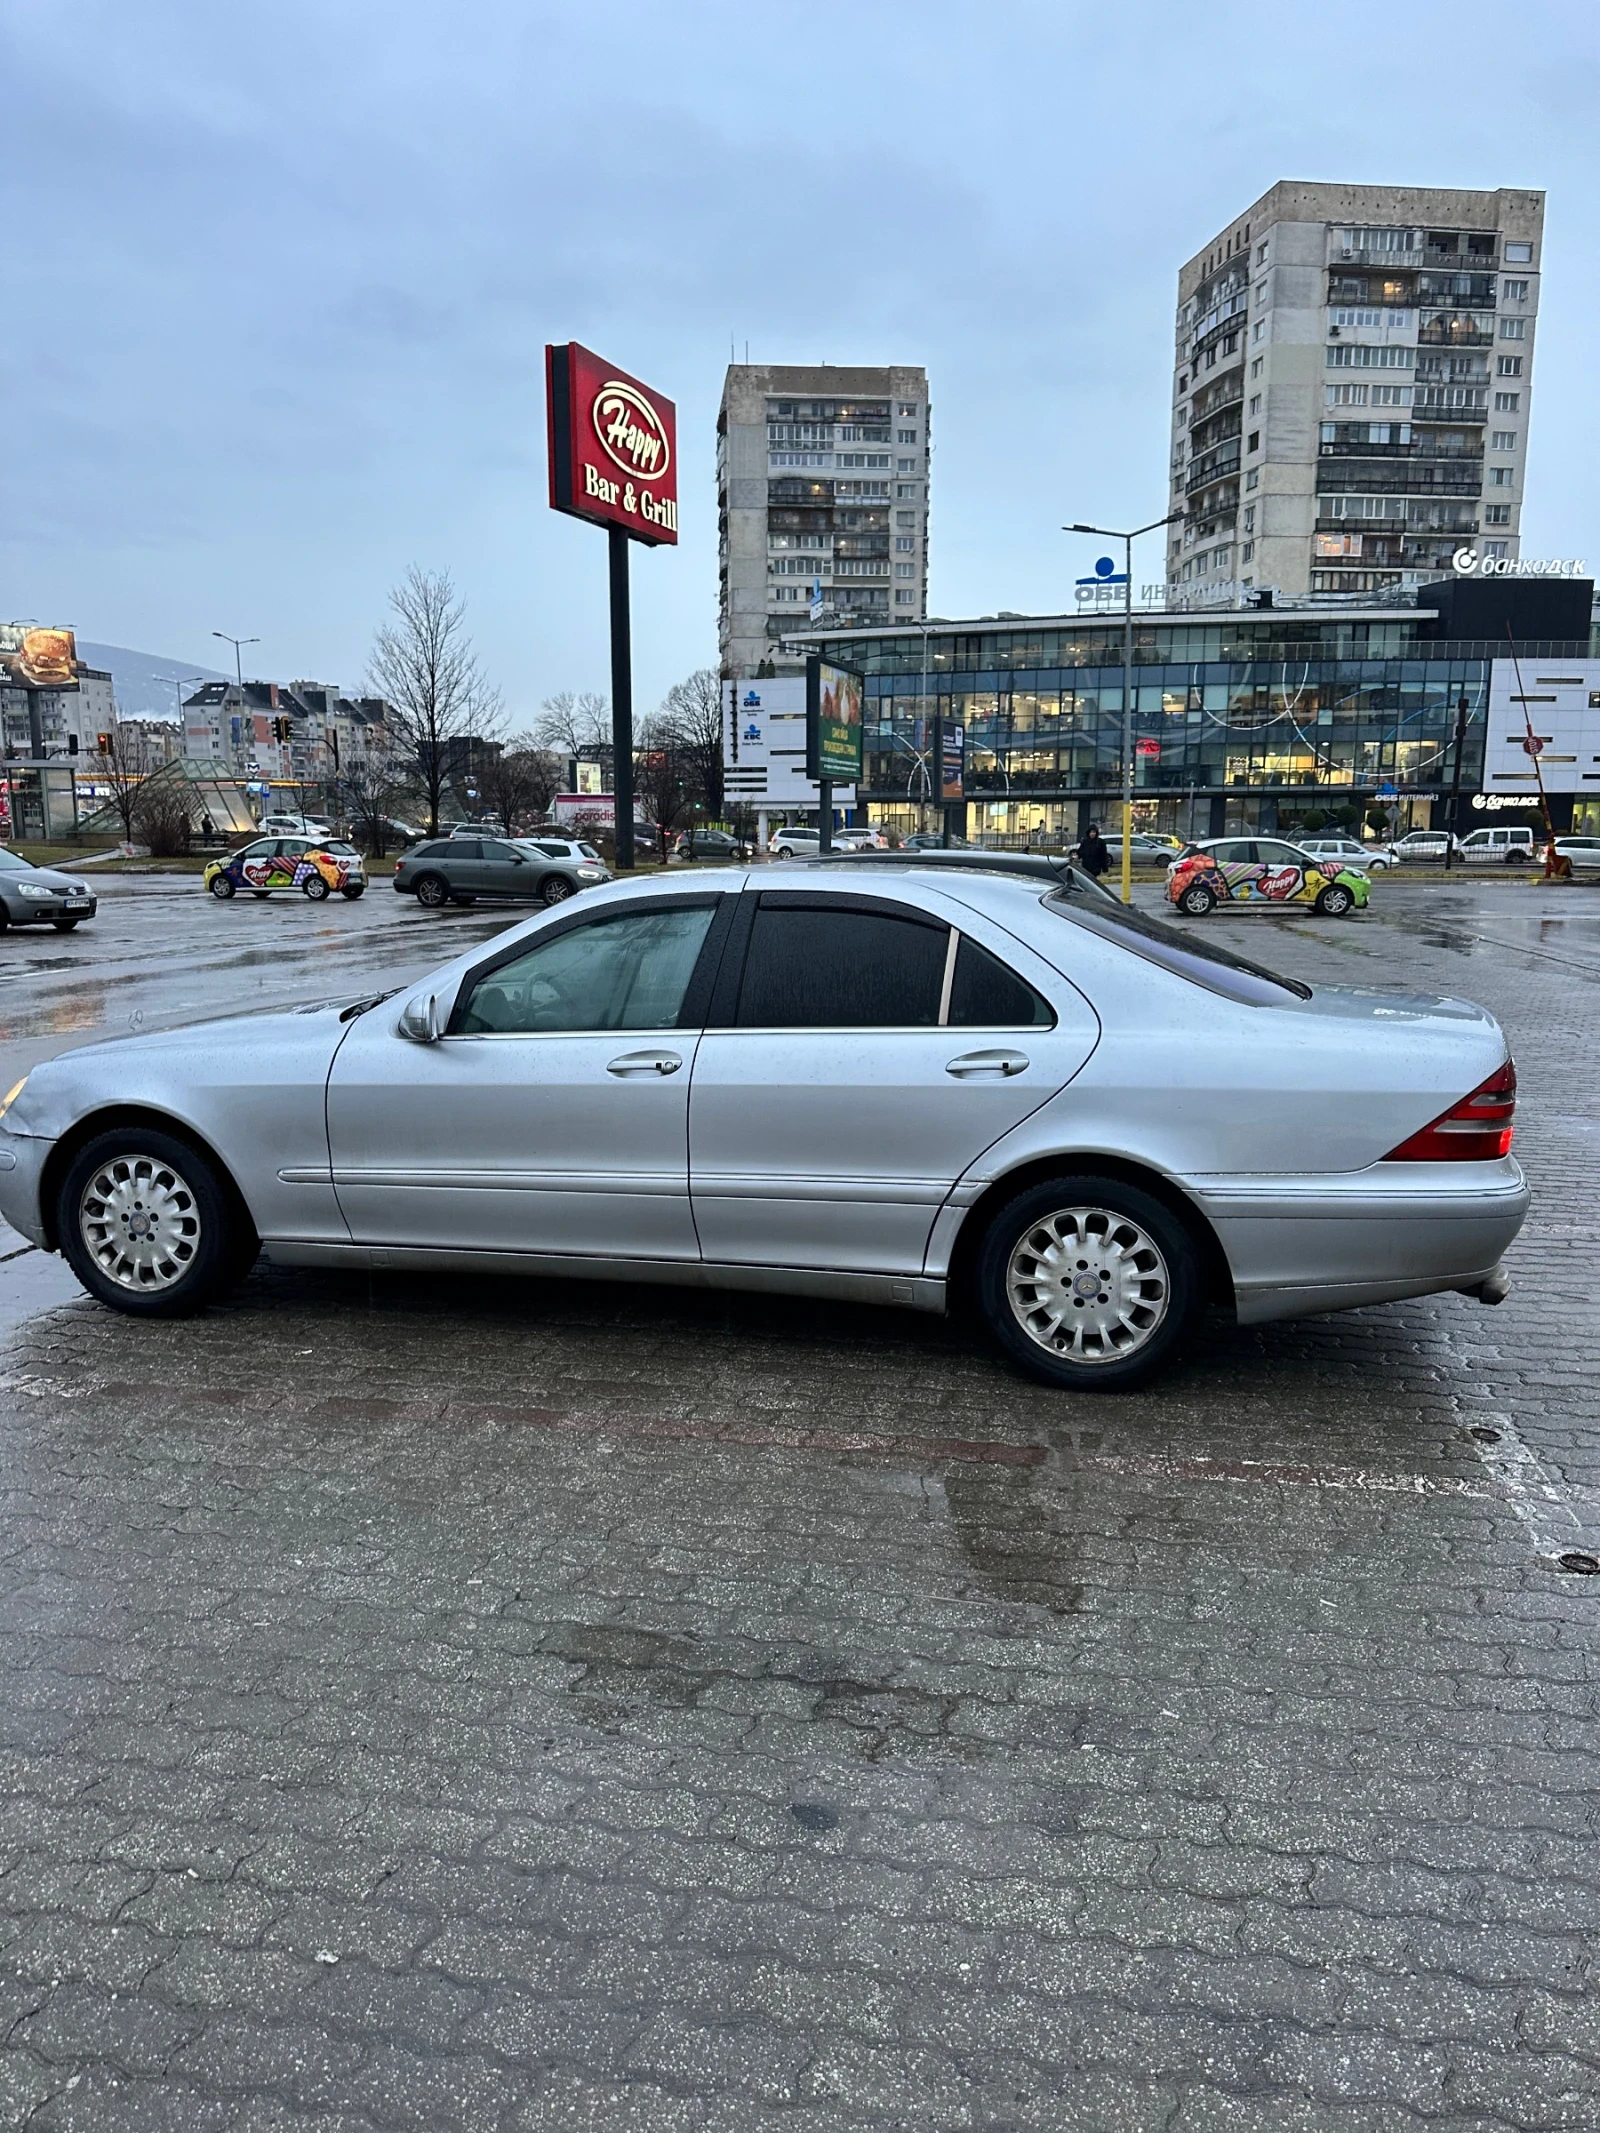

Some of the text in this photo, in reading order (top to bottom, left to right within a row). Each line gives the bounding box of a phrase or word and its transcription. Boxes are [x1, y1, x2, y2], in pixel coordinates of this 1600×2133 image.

[602, 398, 661, 472] Happy
[584, 462, 678, 532] Bar & Grill
[1481, 553, 1587, 575] банкадск
[1528, 737, 1539, 754] STOP
[248, 869, 272, 879] Happy
[1262, 872, 1296, 894] Happy
